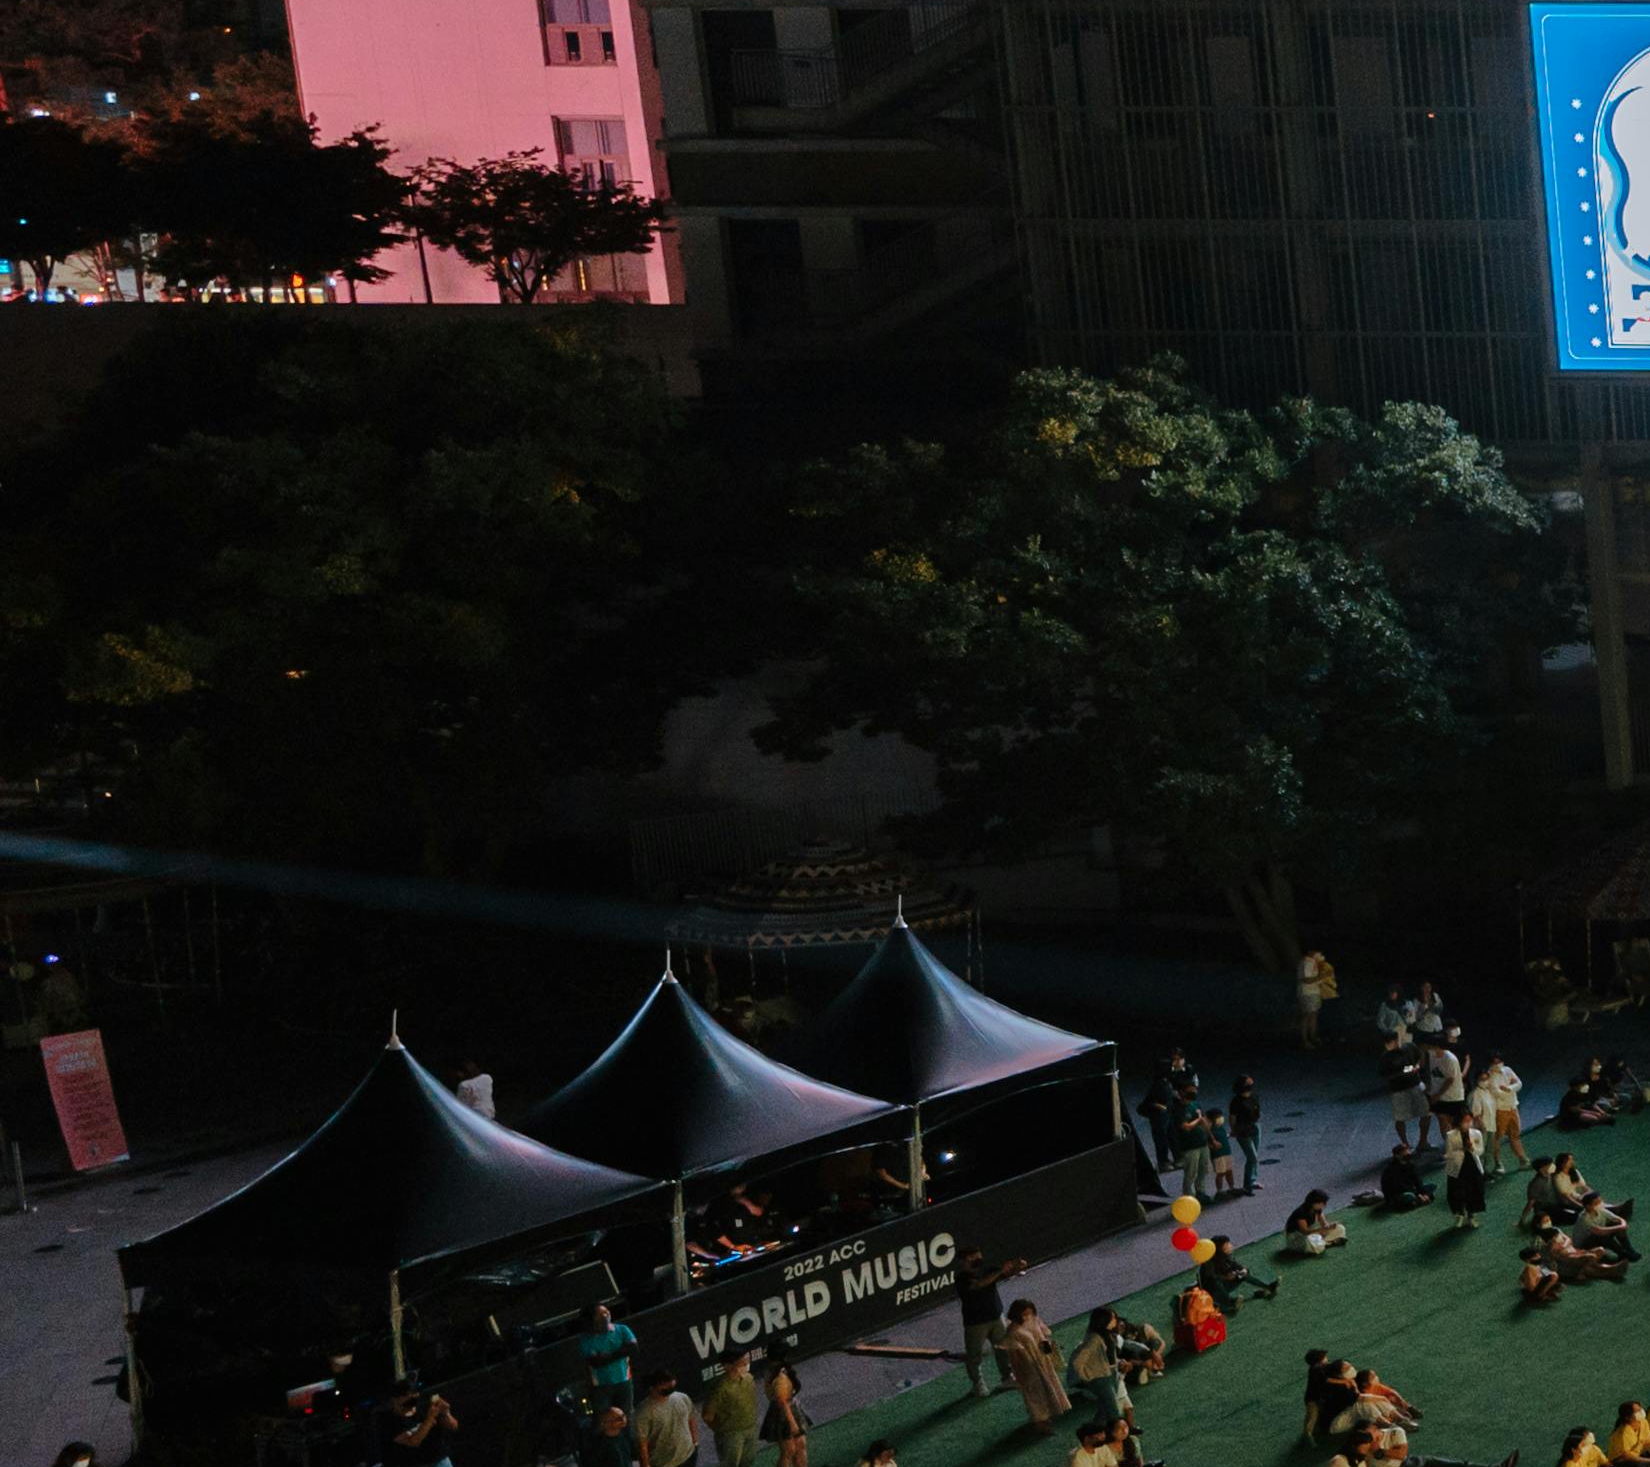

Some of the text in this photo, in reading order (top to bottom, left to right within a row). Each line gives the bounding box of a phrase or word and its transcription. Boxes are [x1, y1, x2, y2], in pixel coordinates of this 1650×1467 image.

[689, 1232, 957, 1360] WORLD MUSIC
[783, 1240, 866, 1281] 2022 ACC
